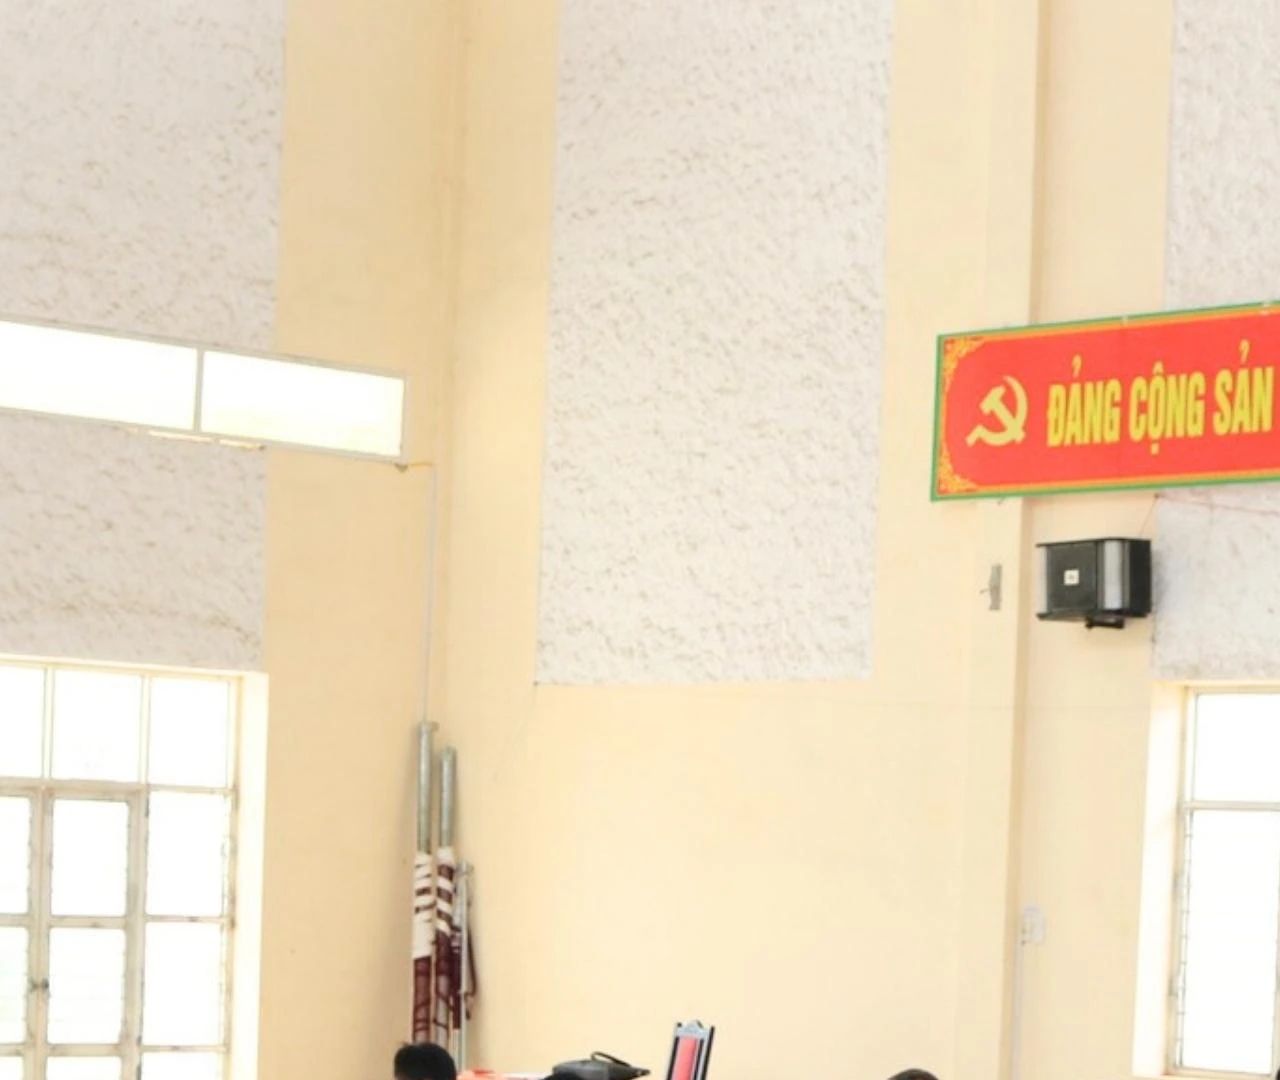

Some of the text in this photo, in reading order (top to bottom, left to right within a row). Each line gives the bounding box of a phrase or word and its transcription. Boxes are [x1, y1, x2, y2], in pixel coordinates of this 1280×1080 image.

[1046, 354, 1122, 448] ĐẢNG
[1128, 360, 1207, 456] CỘNG
[1212, 339, 1275, 437] SẢN
